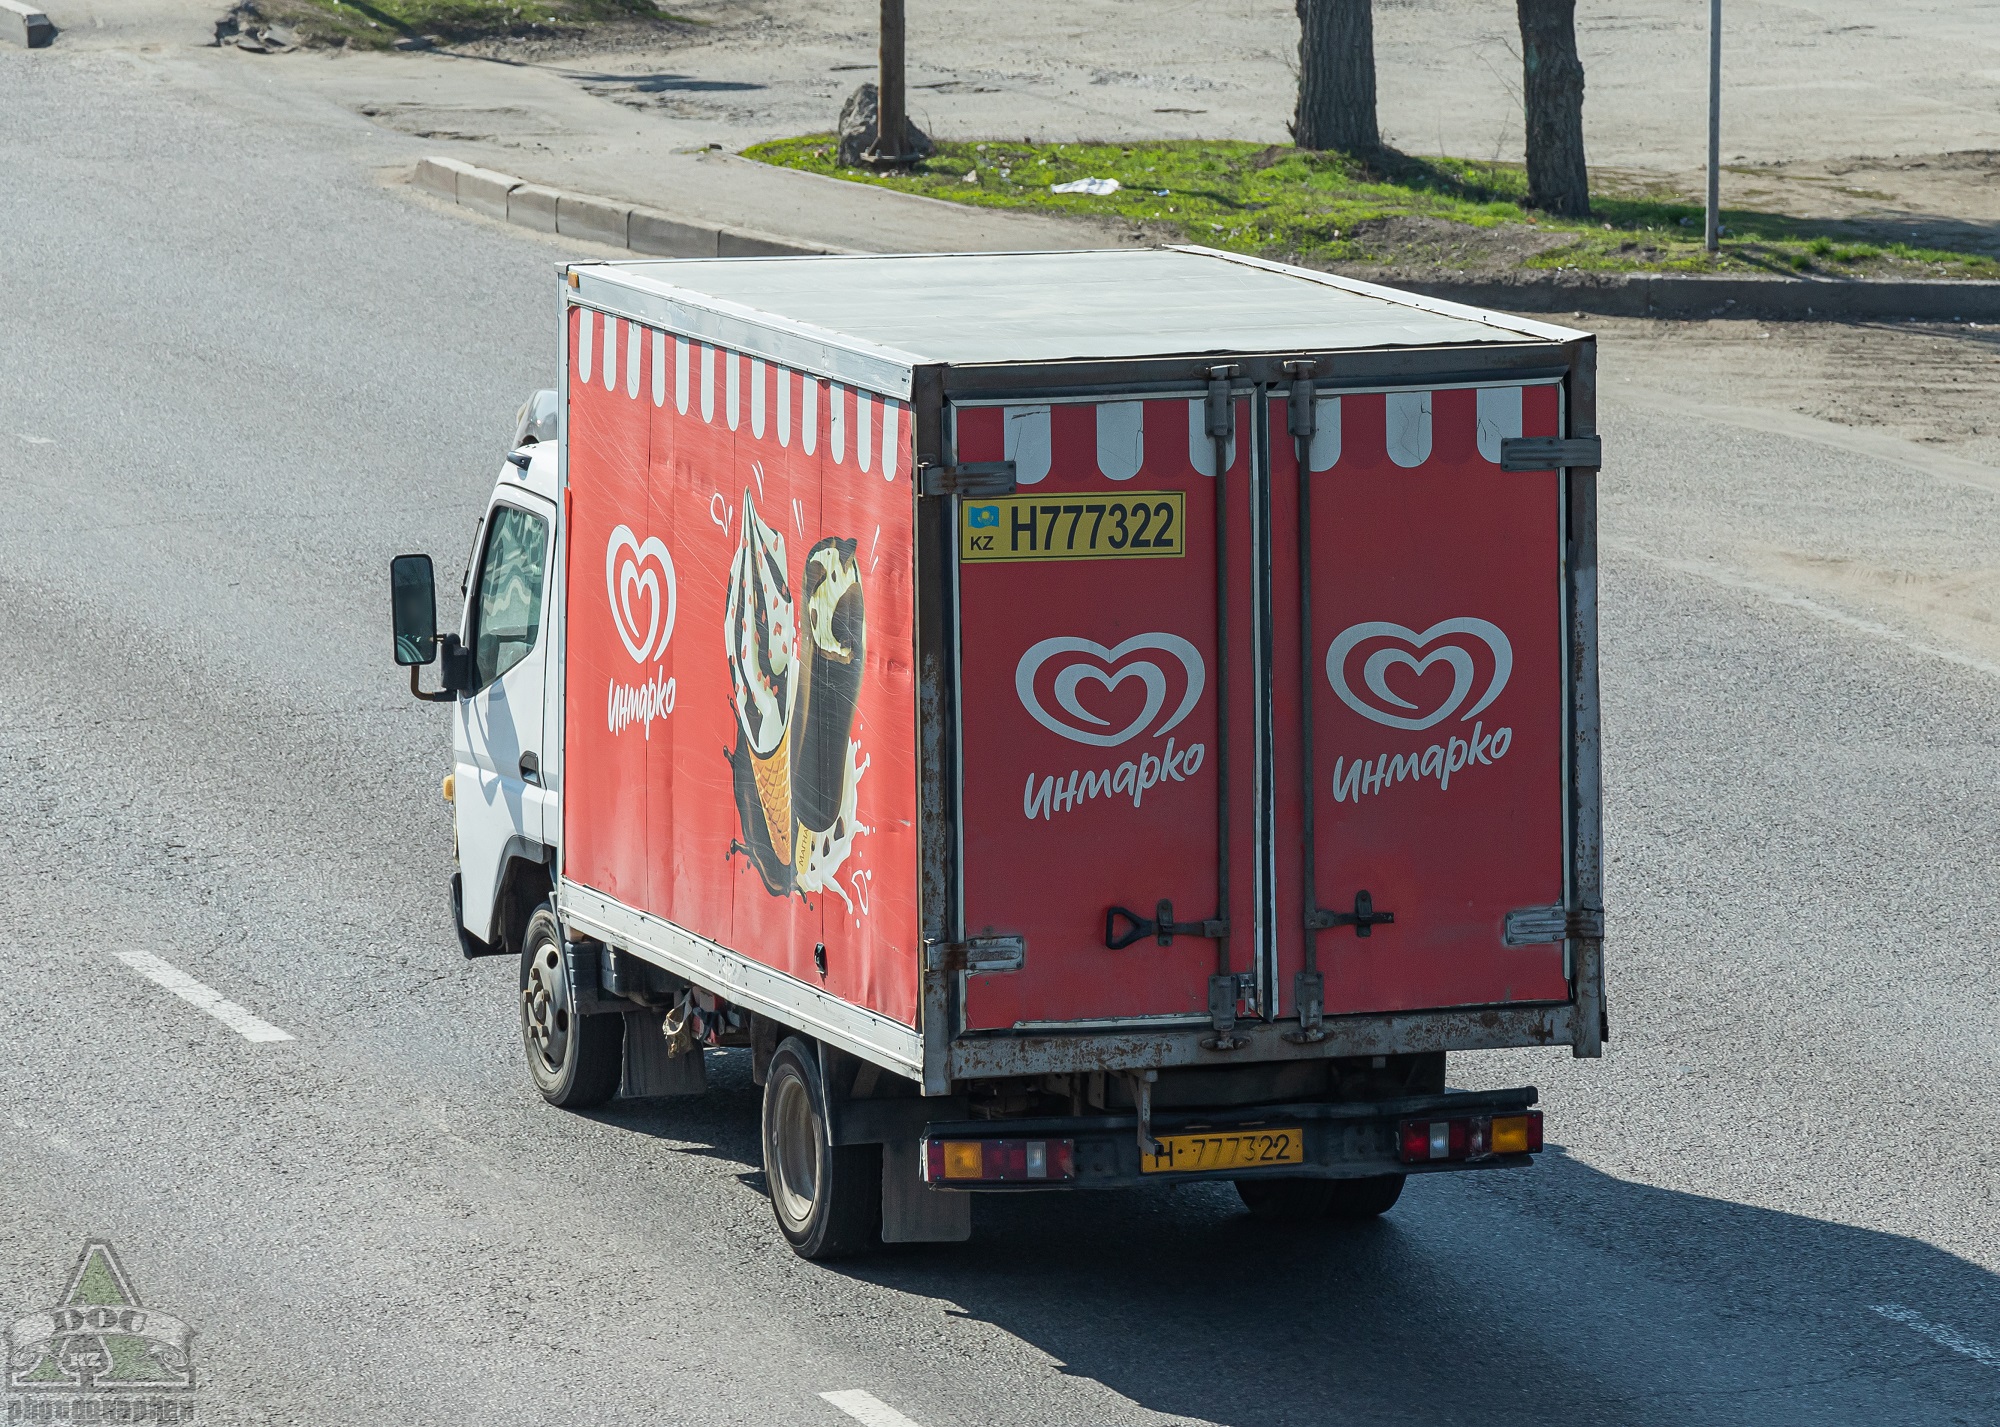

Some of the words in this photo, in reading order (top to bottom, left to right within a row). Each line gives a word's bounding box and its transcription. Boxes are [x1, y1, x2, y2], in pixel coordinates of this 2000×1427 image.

[970, 536, 994, 551] KZ
[1011, 502, 1174, 551] H777322
[608, 665, 676, 741] Инмарко
[1023, 737, 1206, 821] Инмарко
[1332, 720, 1513, 804] Инмарко
